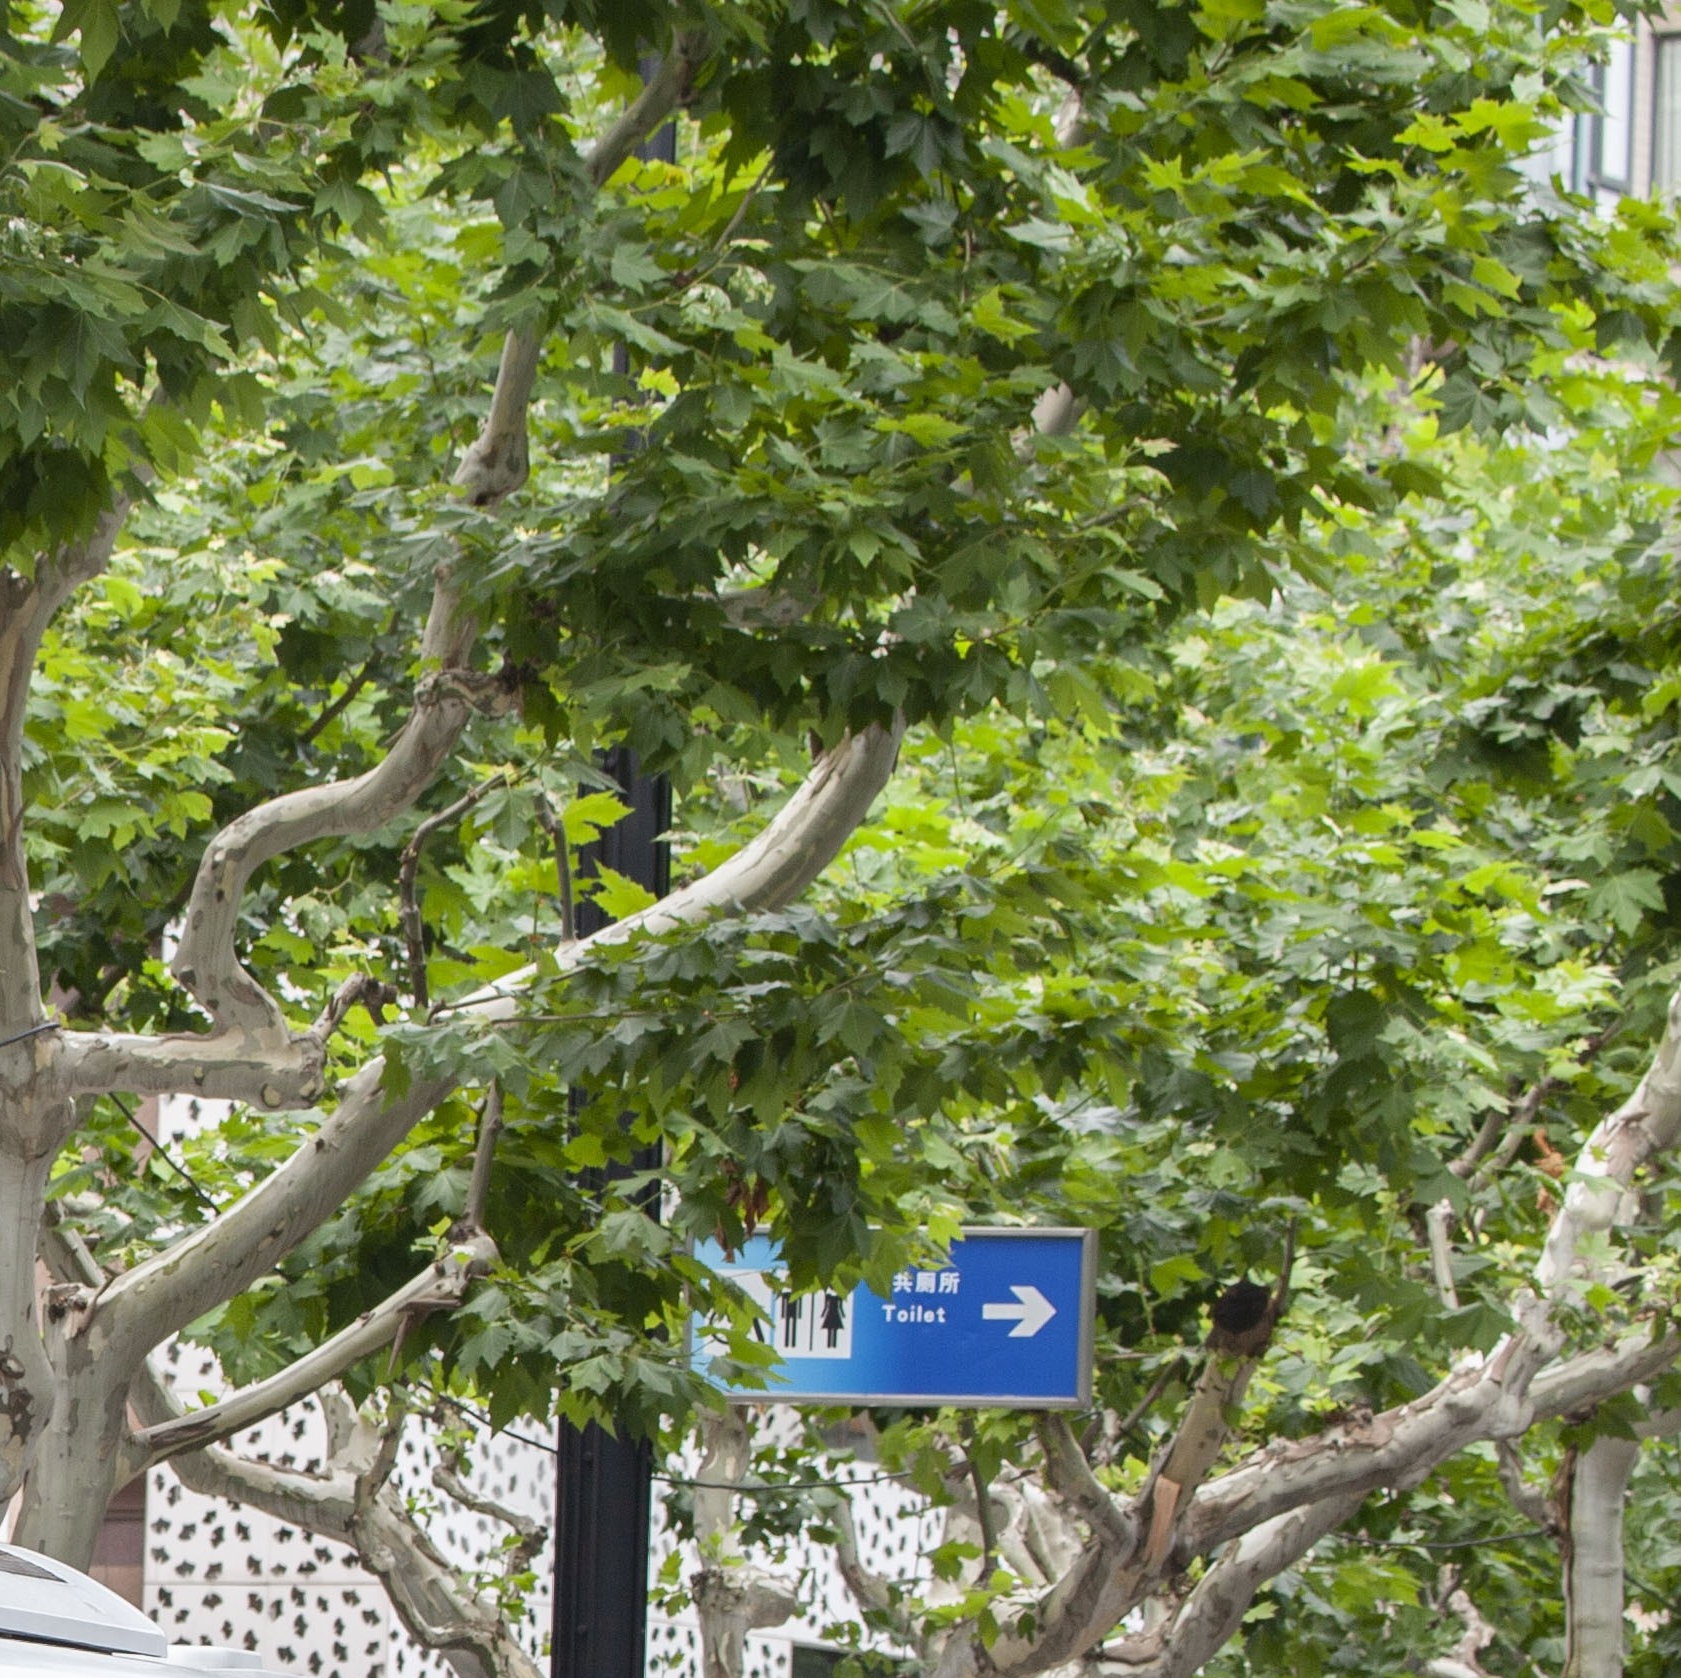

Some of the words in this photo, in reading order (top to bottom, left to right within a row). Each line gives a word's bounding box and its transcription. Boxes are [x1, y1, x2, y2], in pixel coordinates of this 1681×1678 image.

[892, 1271, 961, 1294] 共厕所
[881, 1304, 946, 1323] Toilet
